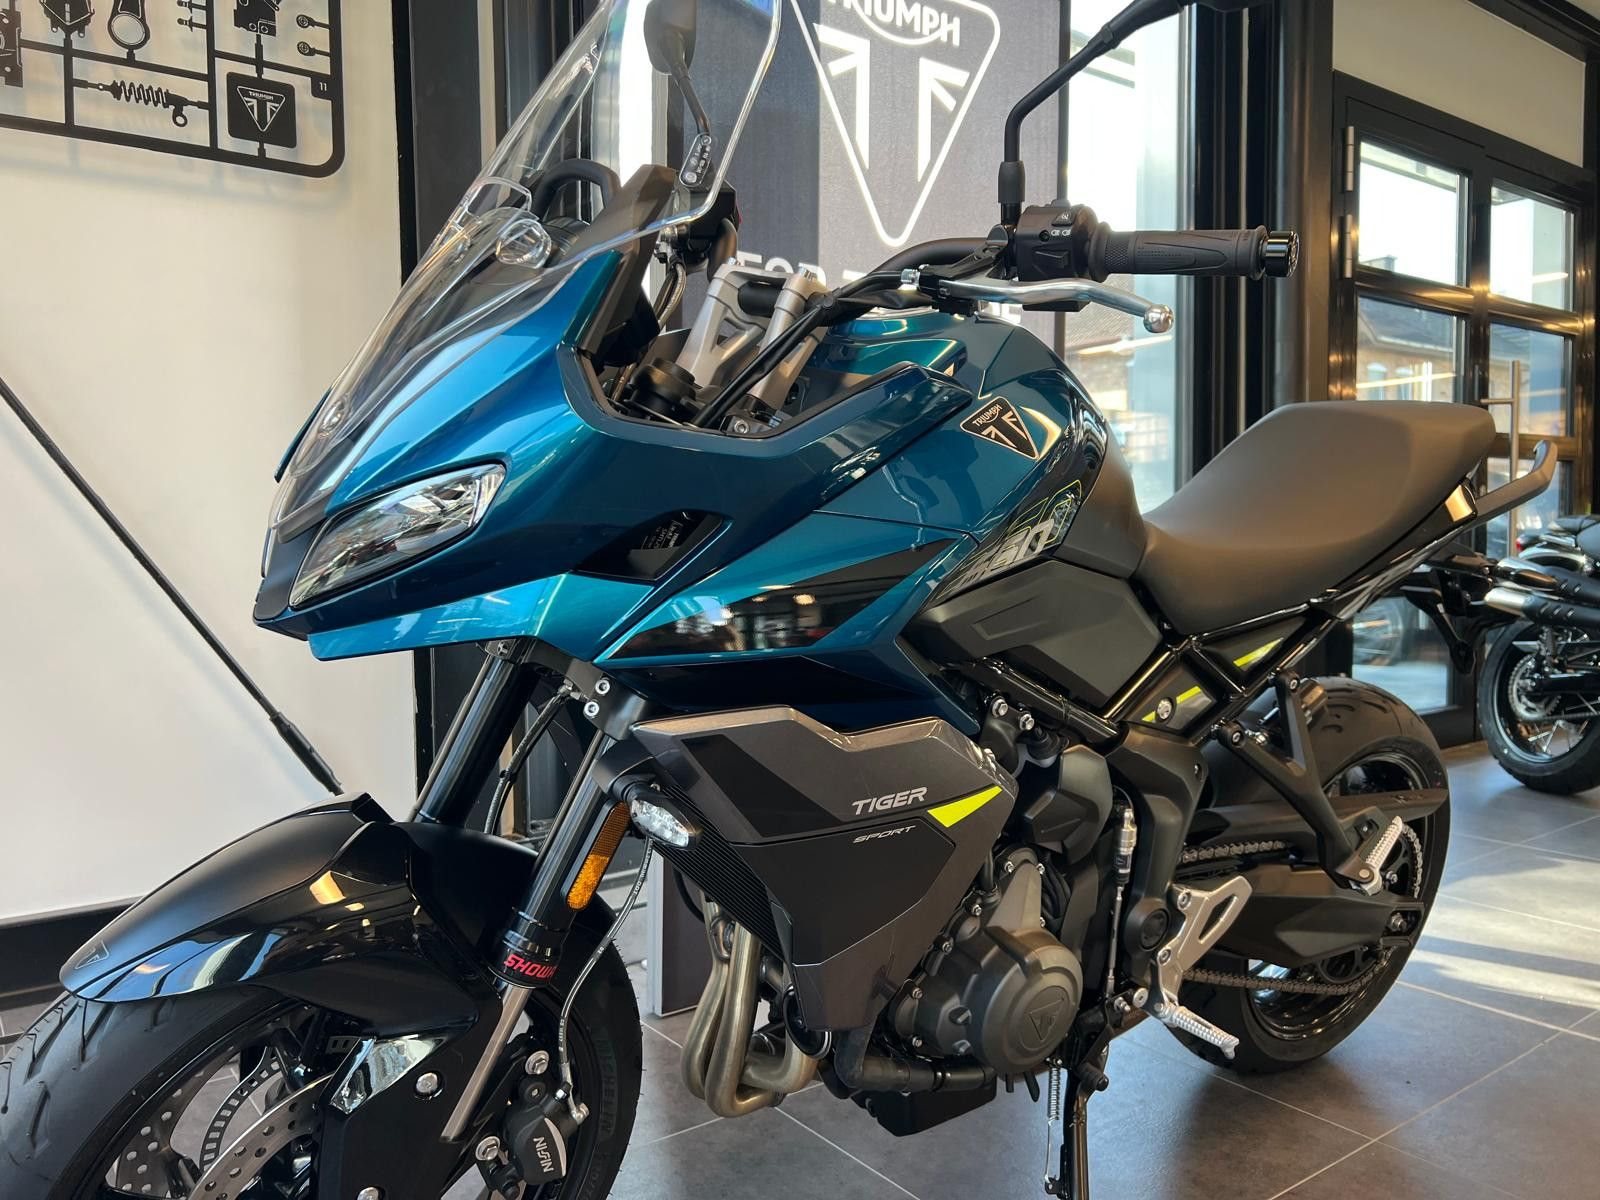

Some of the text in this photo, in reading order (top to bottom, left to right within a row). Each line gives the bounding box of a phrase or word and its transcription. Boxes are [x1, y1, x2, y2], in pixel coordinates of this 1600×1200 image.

[972, 404, 1003, 427] TRIUMPH
[852, 786, 928, 815] TIGER
[853, 825, 916, 844] SPORT
[533, 1137, 554, 1172] NISSIN
